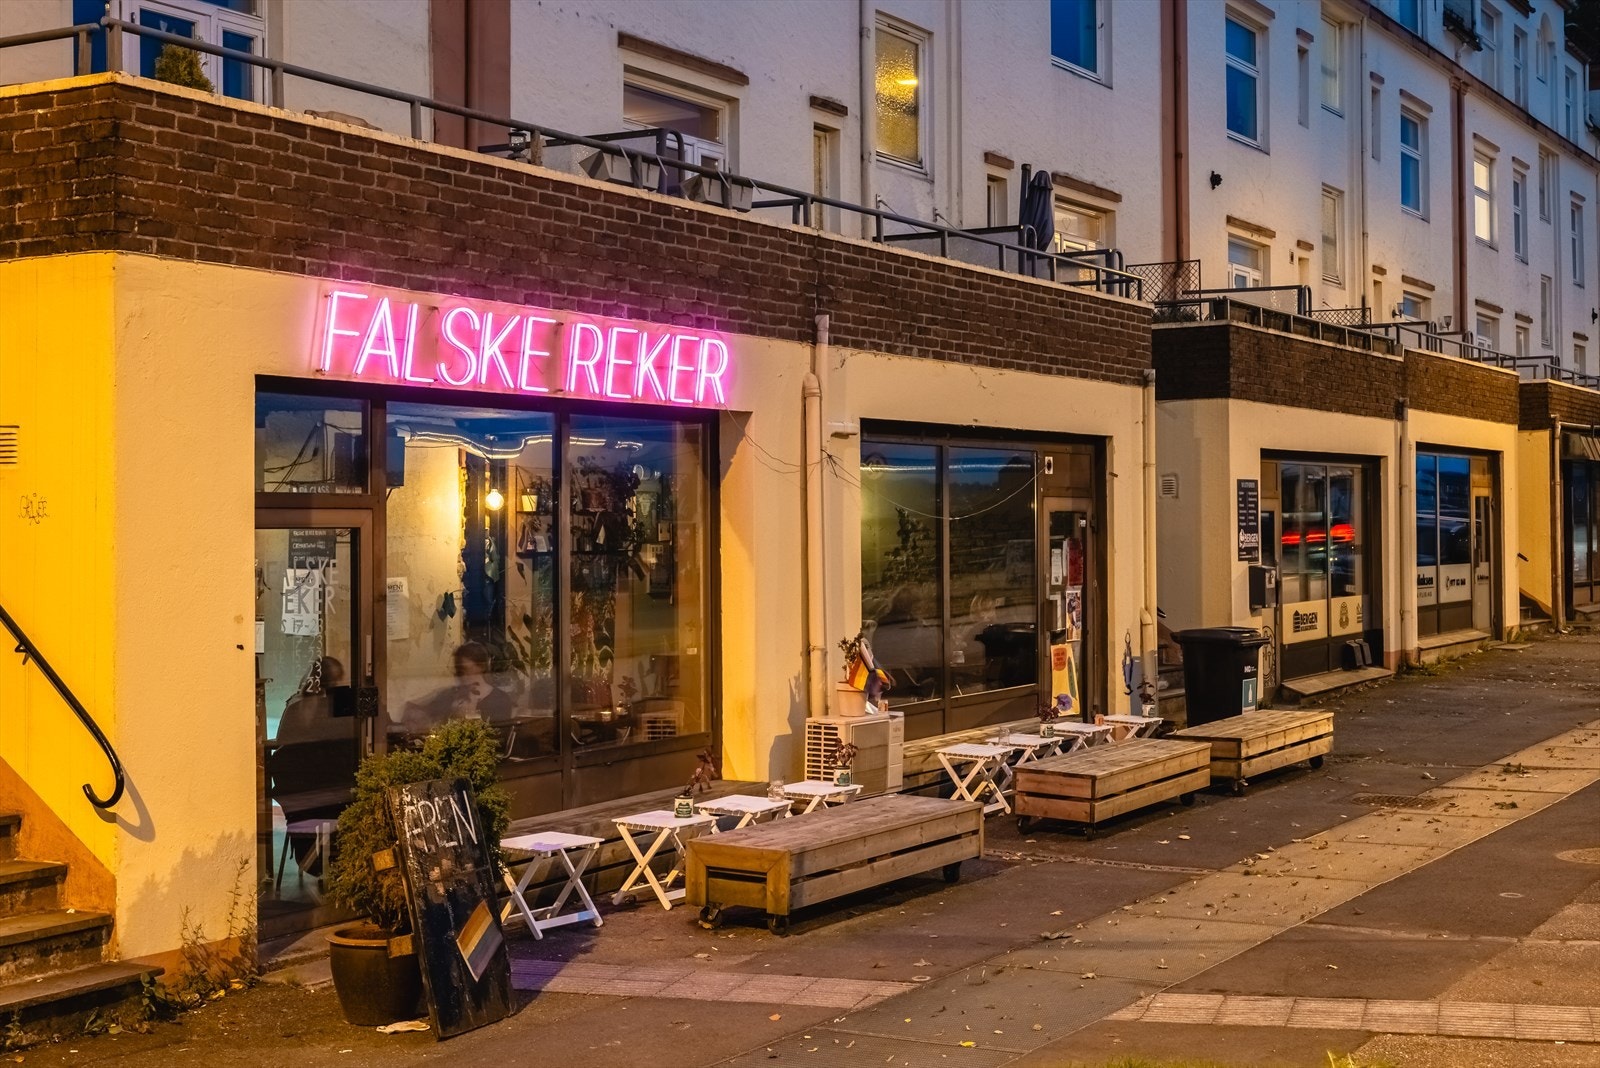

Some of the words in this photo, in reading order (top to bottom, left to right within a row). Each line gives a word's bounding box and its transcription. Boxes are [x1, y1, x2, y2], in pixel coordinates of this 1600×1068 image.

[319, 290, 558, 394] FALSKE
[565, 321, 731, 405] REKER
[1300, 612, 1319, 626] BERGEN
